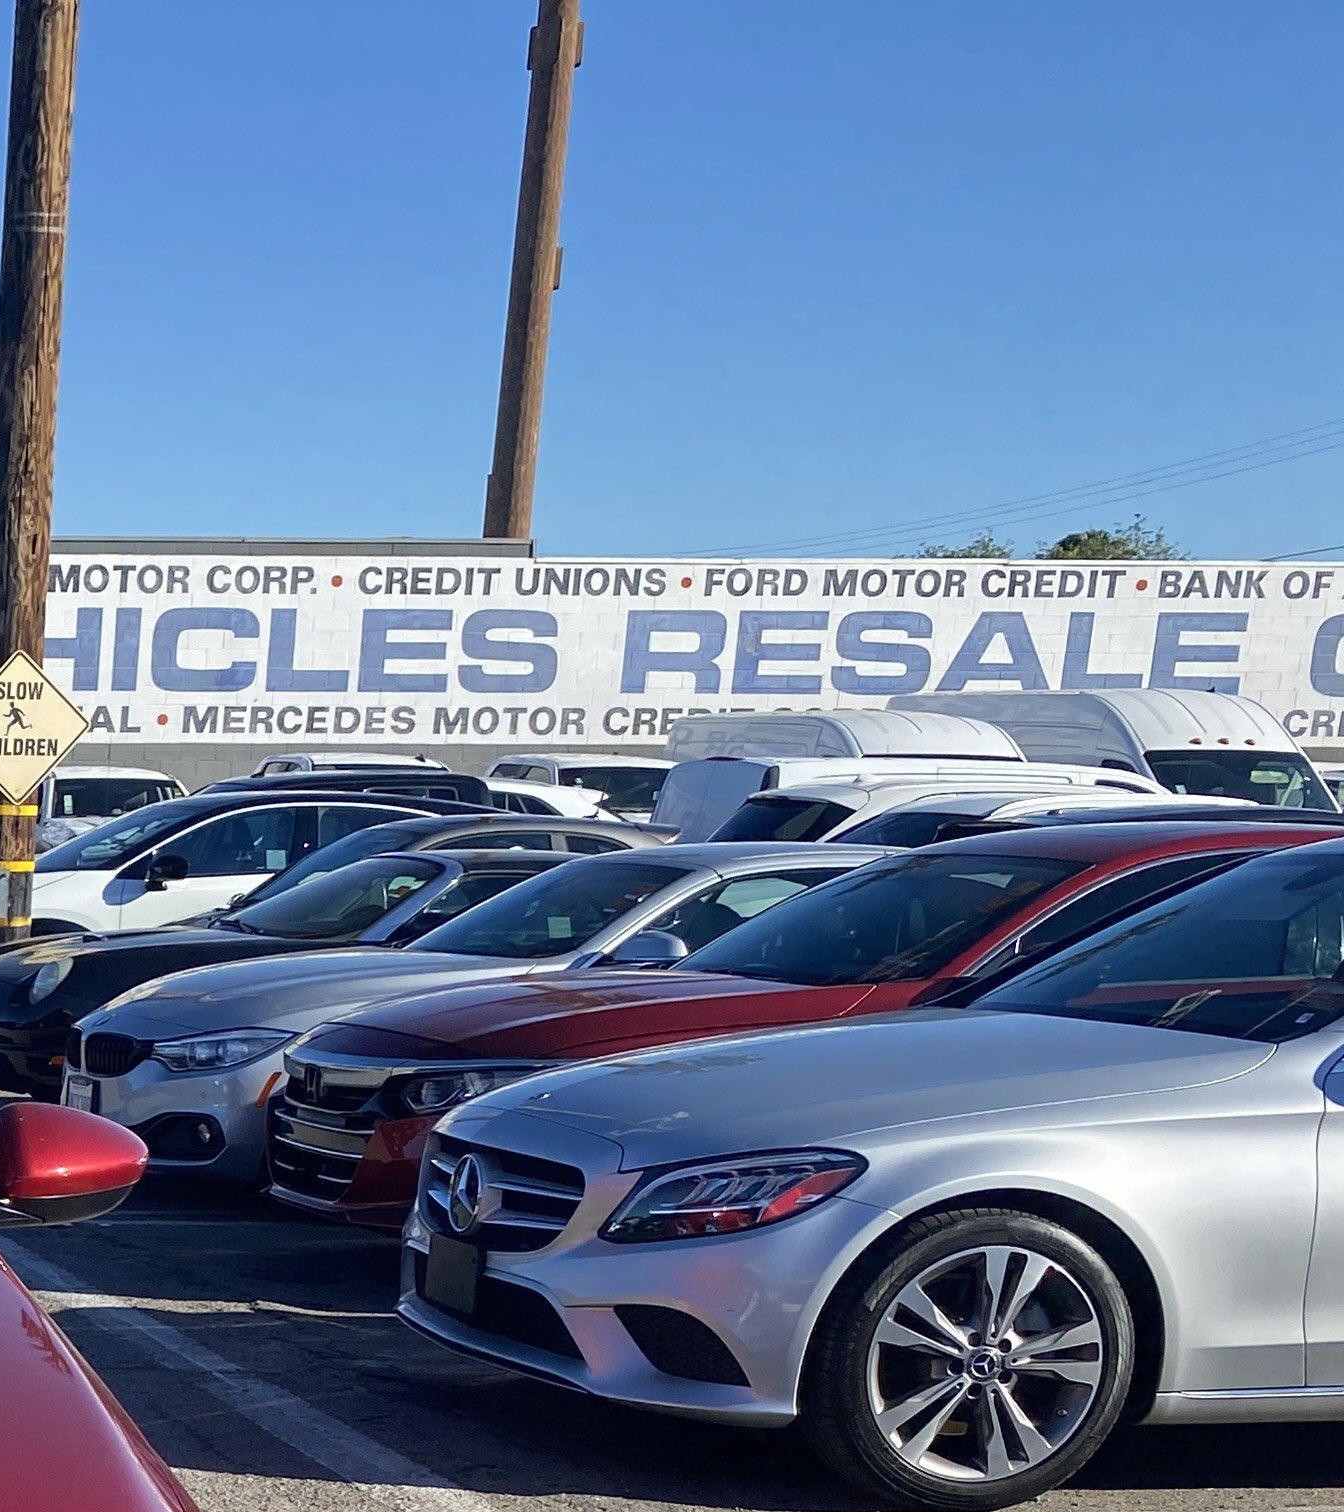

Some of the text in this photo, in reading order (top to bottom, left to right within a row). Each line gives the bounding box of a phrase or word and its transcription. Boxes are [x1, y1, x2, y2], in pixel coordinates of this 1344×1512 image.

[47, 564, 190, 594] MOTOR
[206, 565, 318, 595] CORP.
[358, 566, 502, 596] CREDIT
[515, 567, 667, 597] UNIONS
[704, 568, 808, 597] FORD
[822, 568, 968, 598] MOTOR
[981, 569, 1127, 598] CREDIT
[1158, 570, 1270, 599] BANK
[1283, 570, 1335, 599] OF
[620, 610, 1250, 695] RESALE
[182, 705, 417, 736] MERCEDES
[432, 706, 586, 737] MOTOR
